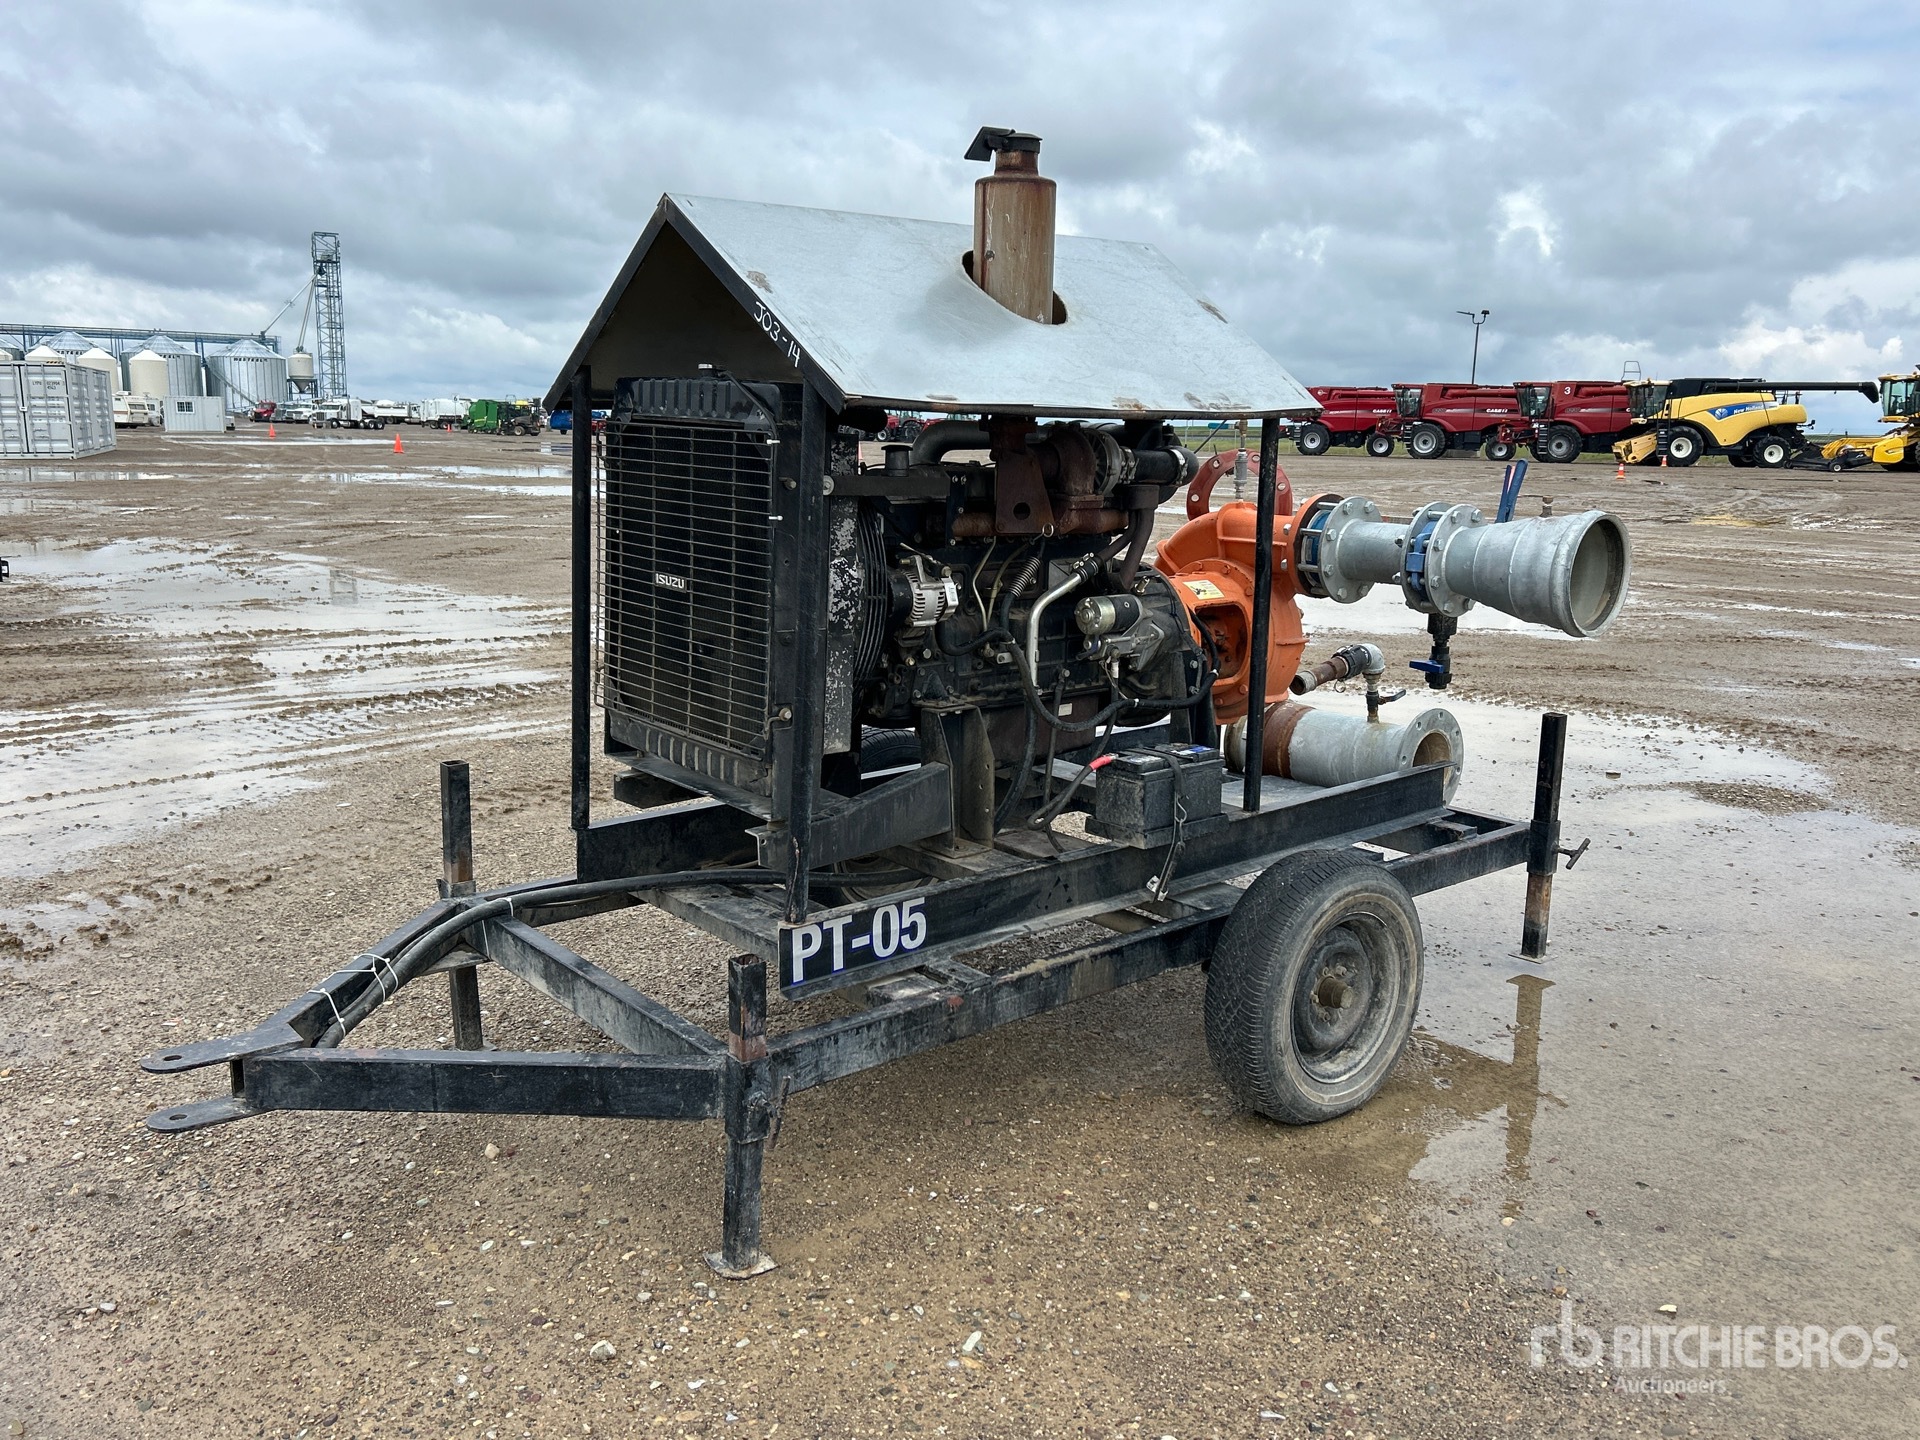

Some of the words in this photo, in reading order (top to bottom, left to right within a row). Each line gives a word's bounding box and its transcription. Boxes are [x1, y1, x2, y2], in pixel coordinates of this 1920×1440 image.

[1564, 386, 1571, 395] 3
[655, 573, 685, 589] ISUZU
[791, 896, 928, 985] PT-05
